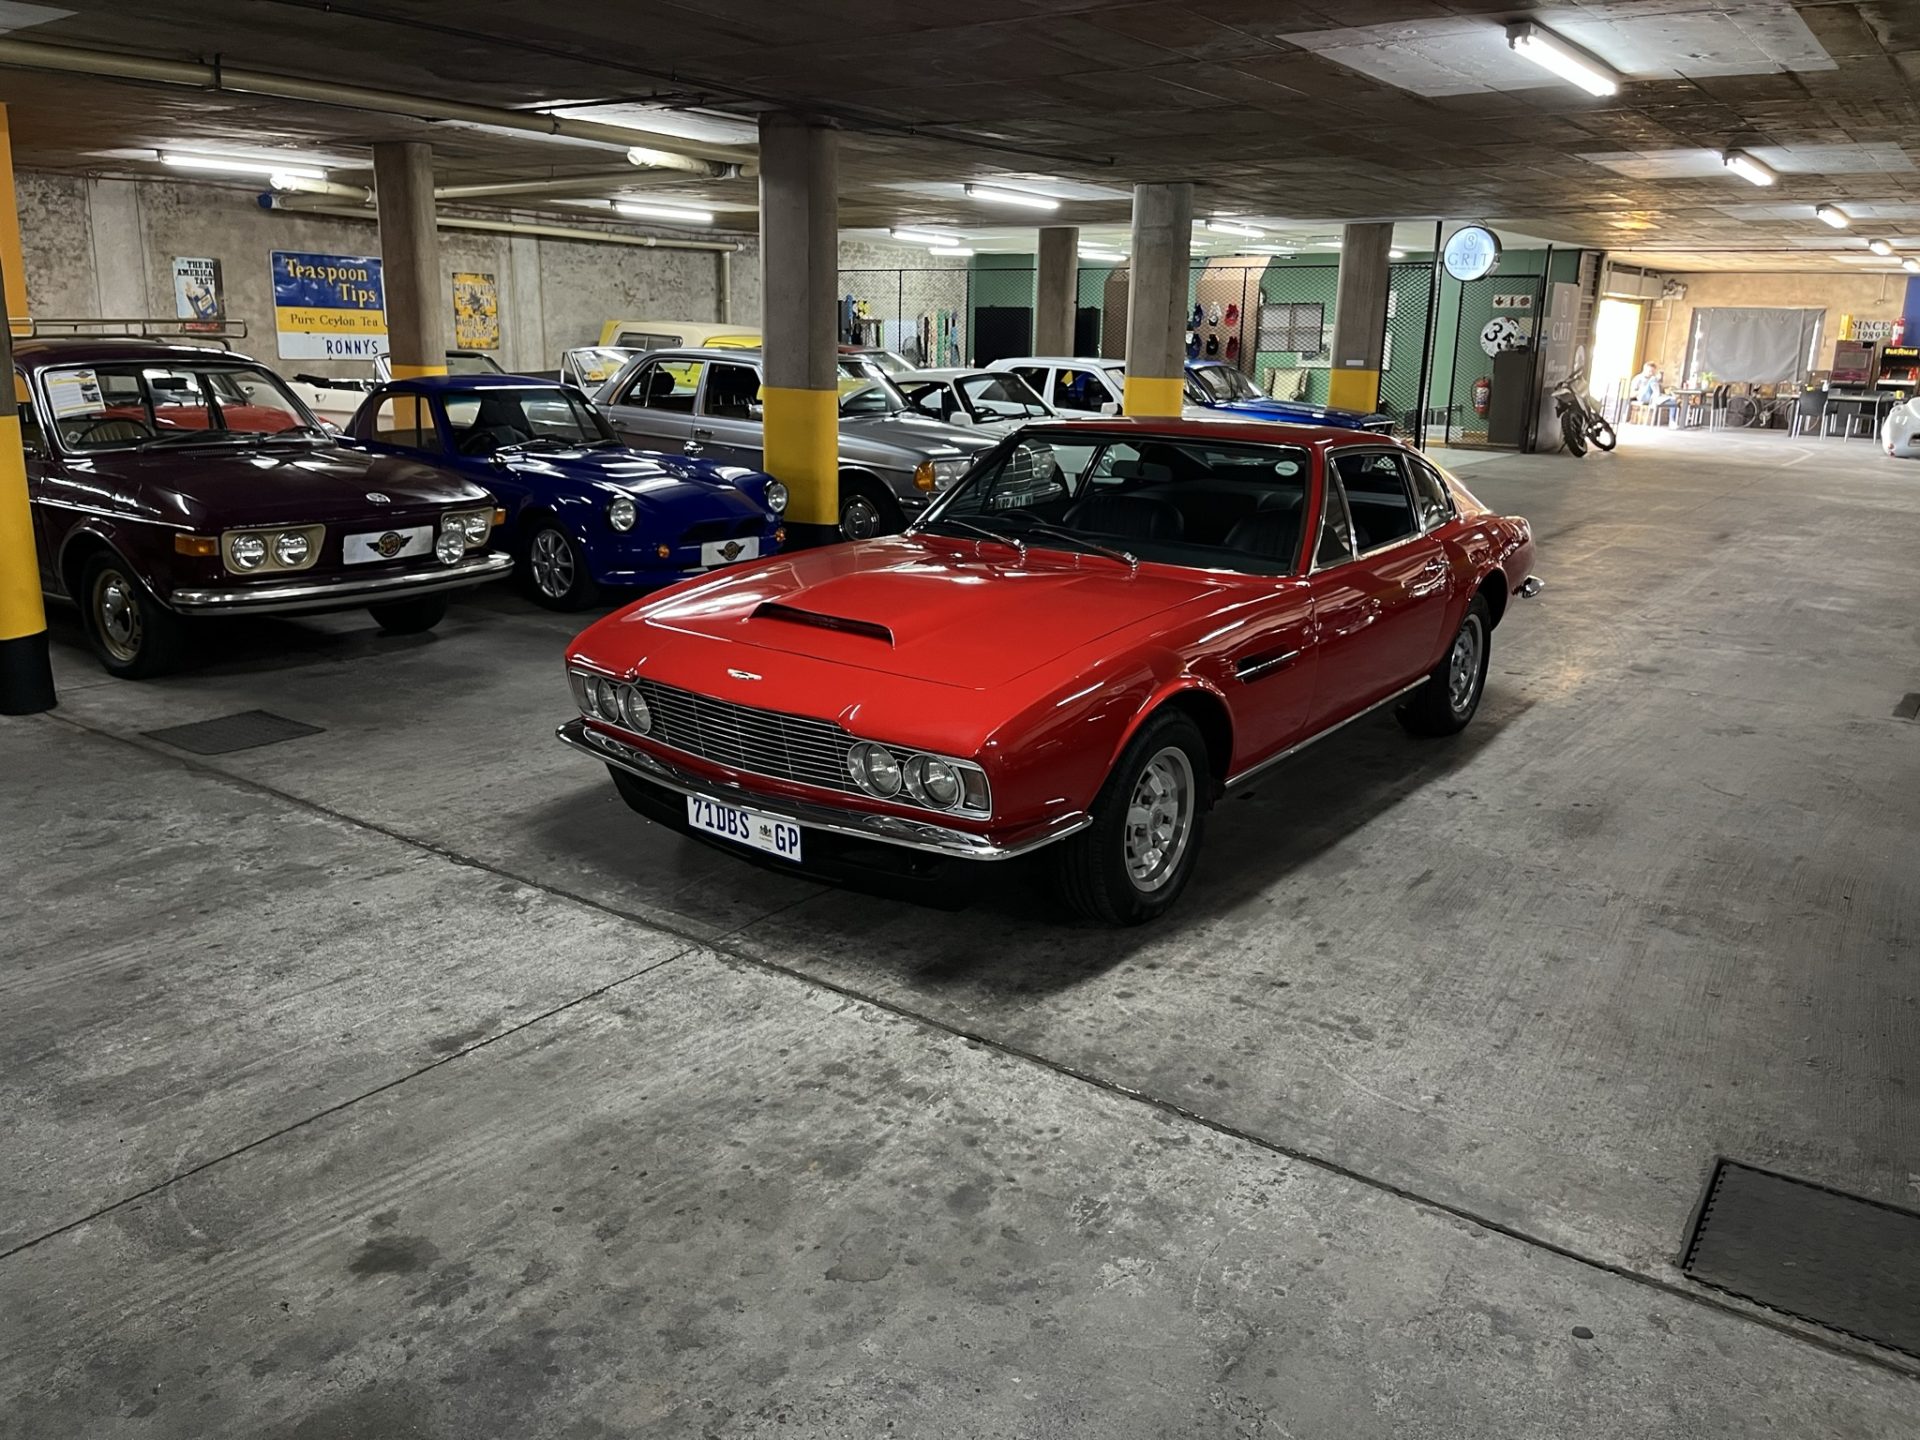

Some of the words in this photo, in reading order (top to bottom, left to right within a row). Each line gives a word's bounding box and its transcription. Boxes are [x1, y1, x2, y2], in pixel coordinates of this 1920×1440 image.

[187, 261, 203, 269] THE
[1448, 252, 1489, 266] GRIT
[178, 269, 213, 277] AMERICA
[286, 258, 368, 286] Teaspoon
[194, 277, 214, 285] TAST
[340, 283, 376, 308] Tips
[290, 313, 315, 325] Pure
[320, 315, 355, 328] Ceylon
[360, 316, 378, 327] Tea
[1851, 320, 1891, 331] SINCE
[1552, 321, 1572, 342] GRIT
[1857, 330, 1881, 340] 1989
[326, 339, 379, 355] RONNYS
[693, 800, 750, 839] 71DBS
[774, 823, 799, 855] GP
